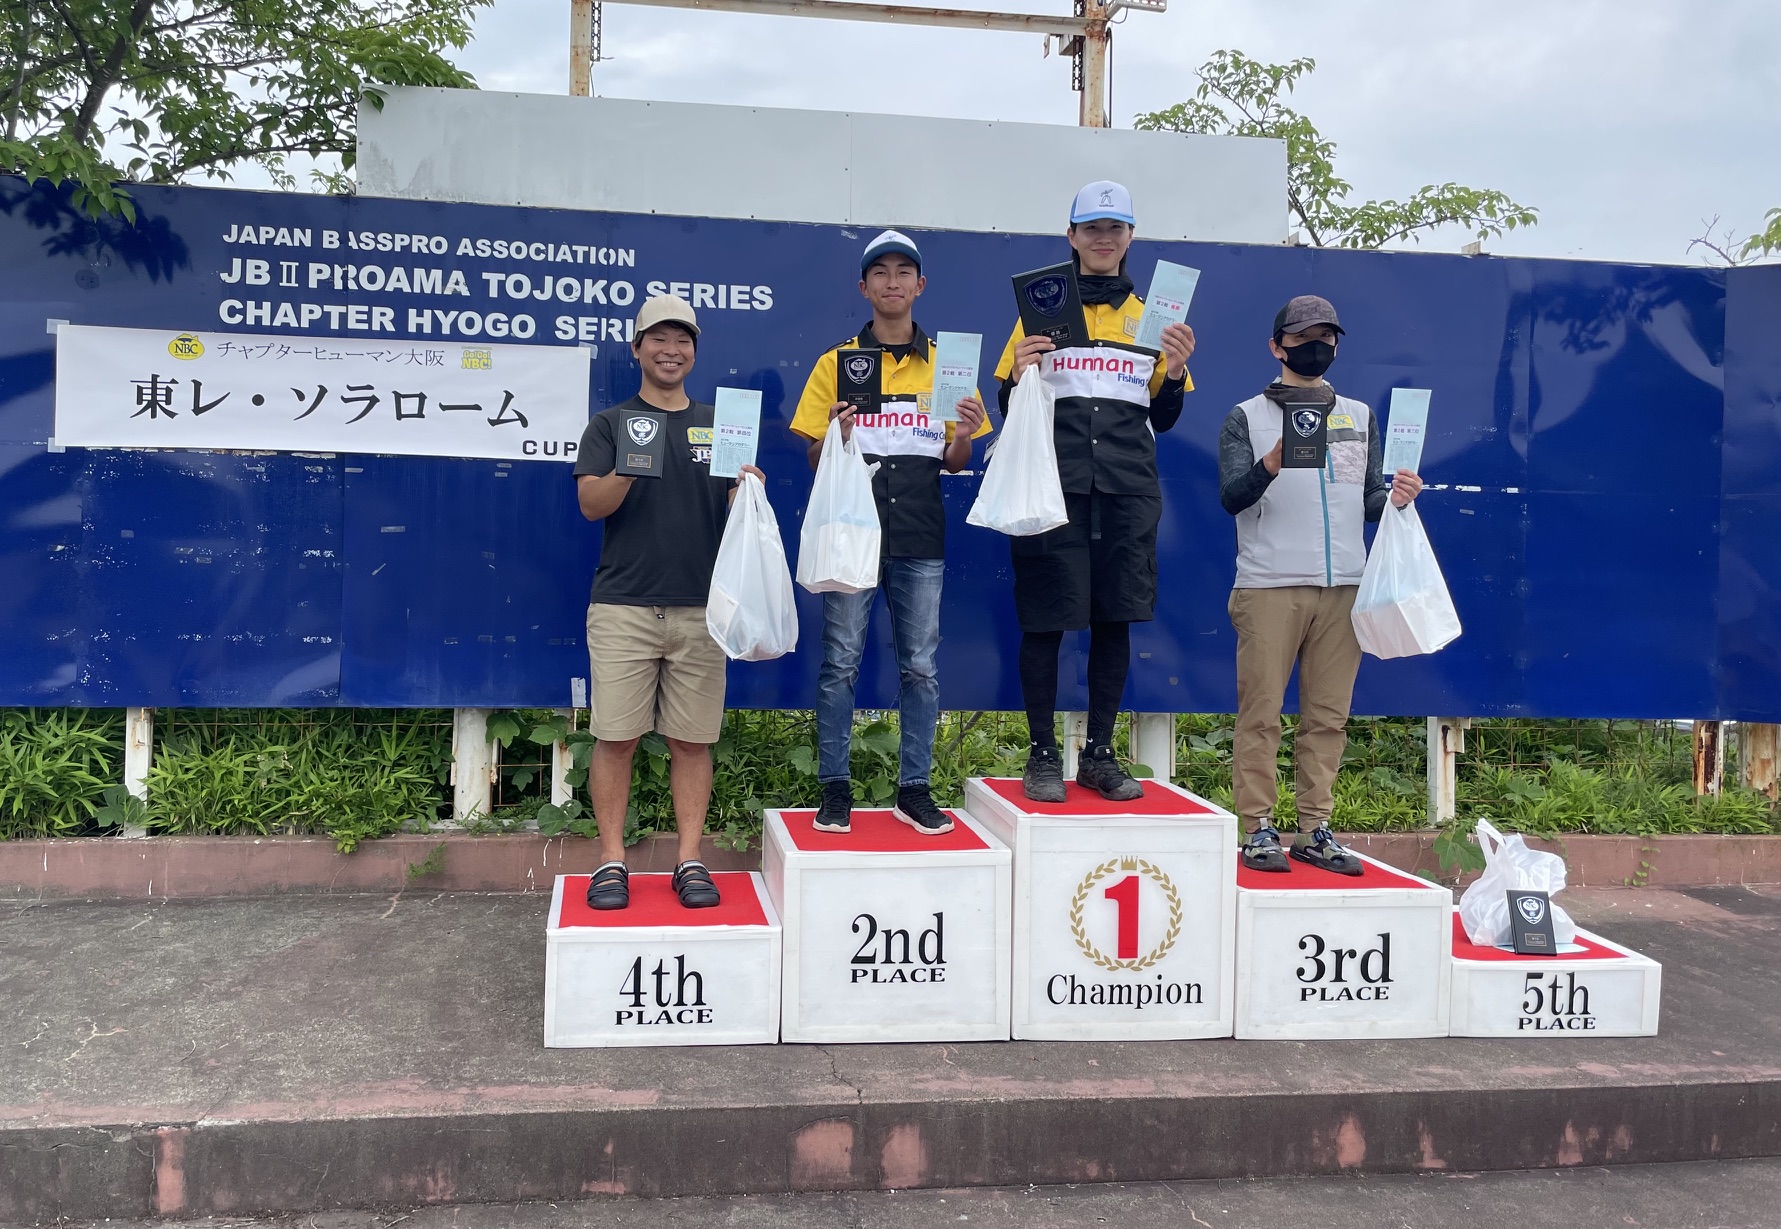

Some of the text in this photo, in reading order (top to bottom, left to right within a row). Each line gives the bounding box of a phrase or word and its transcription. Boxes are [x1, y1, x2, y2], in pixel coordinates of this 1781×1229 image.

[222, 224, 312, 247] JAPAN
[456, 238, 635, 267] ASSOCIATION
[219, 257, 271, 286] JB
[308, 262, 470, 296] PROAMA
[482, 272, 635, 306] TOJOKO
[645, 280, 774, 311] SERIES
[218, 299, 635, 343] CHAPTER HYOGO SERI
[174, 343, 198, 354] NBC
[217, 341, 445, 367] チャプターヒューマン大阪
[1053, 357, 1134, 374] Human
[1117, 373, 1145, 387] Fishing
[130, 373, 529, 428] 東レ・ソラローム
[522, 439, 578, 457] CUP
[912, 427, 938, 441] Fishing
[1105, 876, 1139, 959] 1
[850, 911, 947, 965] 2nd
[1296, 932, 1394, 984] 3rd
[619, 954, 707, 1008] 4th
[850, 967, 946, 984] PLACE
[1047, 974, 1204, 1009] Champion
[1300, 985, 1391, 1002] PLACE
[1522, 972, 1592, 1016] 5th
[614, 1008, 714, 1026] PLACE
[1518, 1016, 1597, 1031] PLACE
